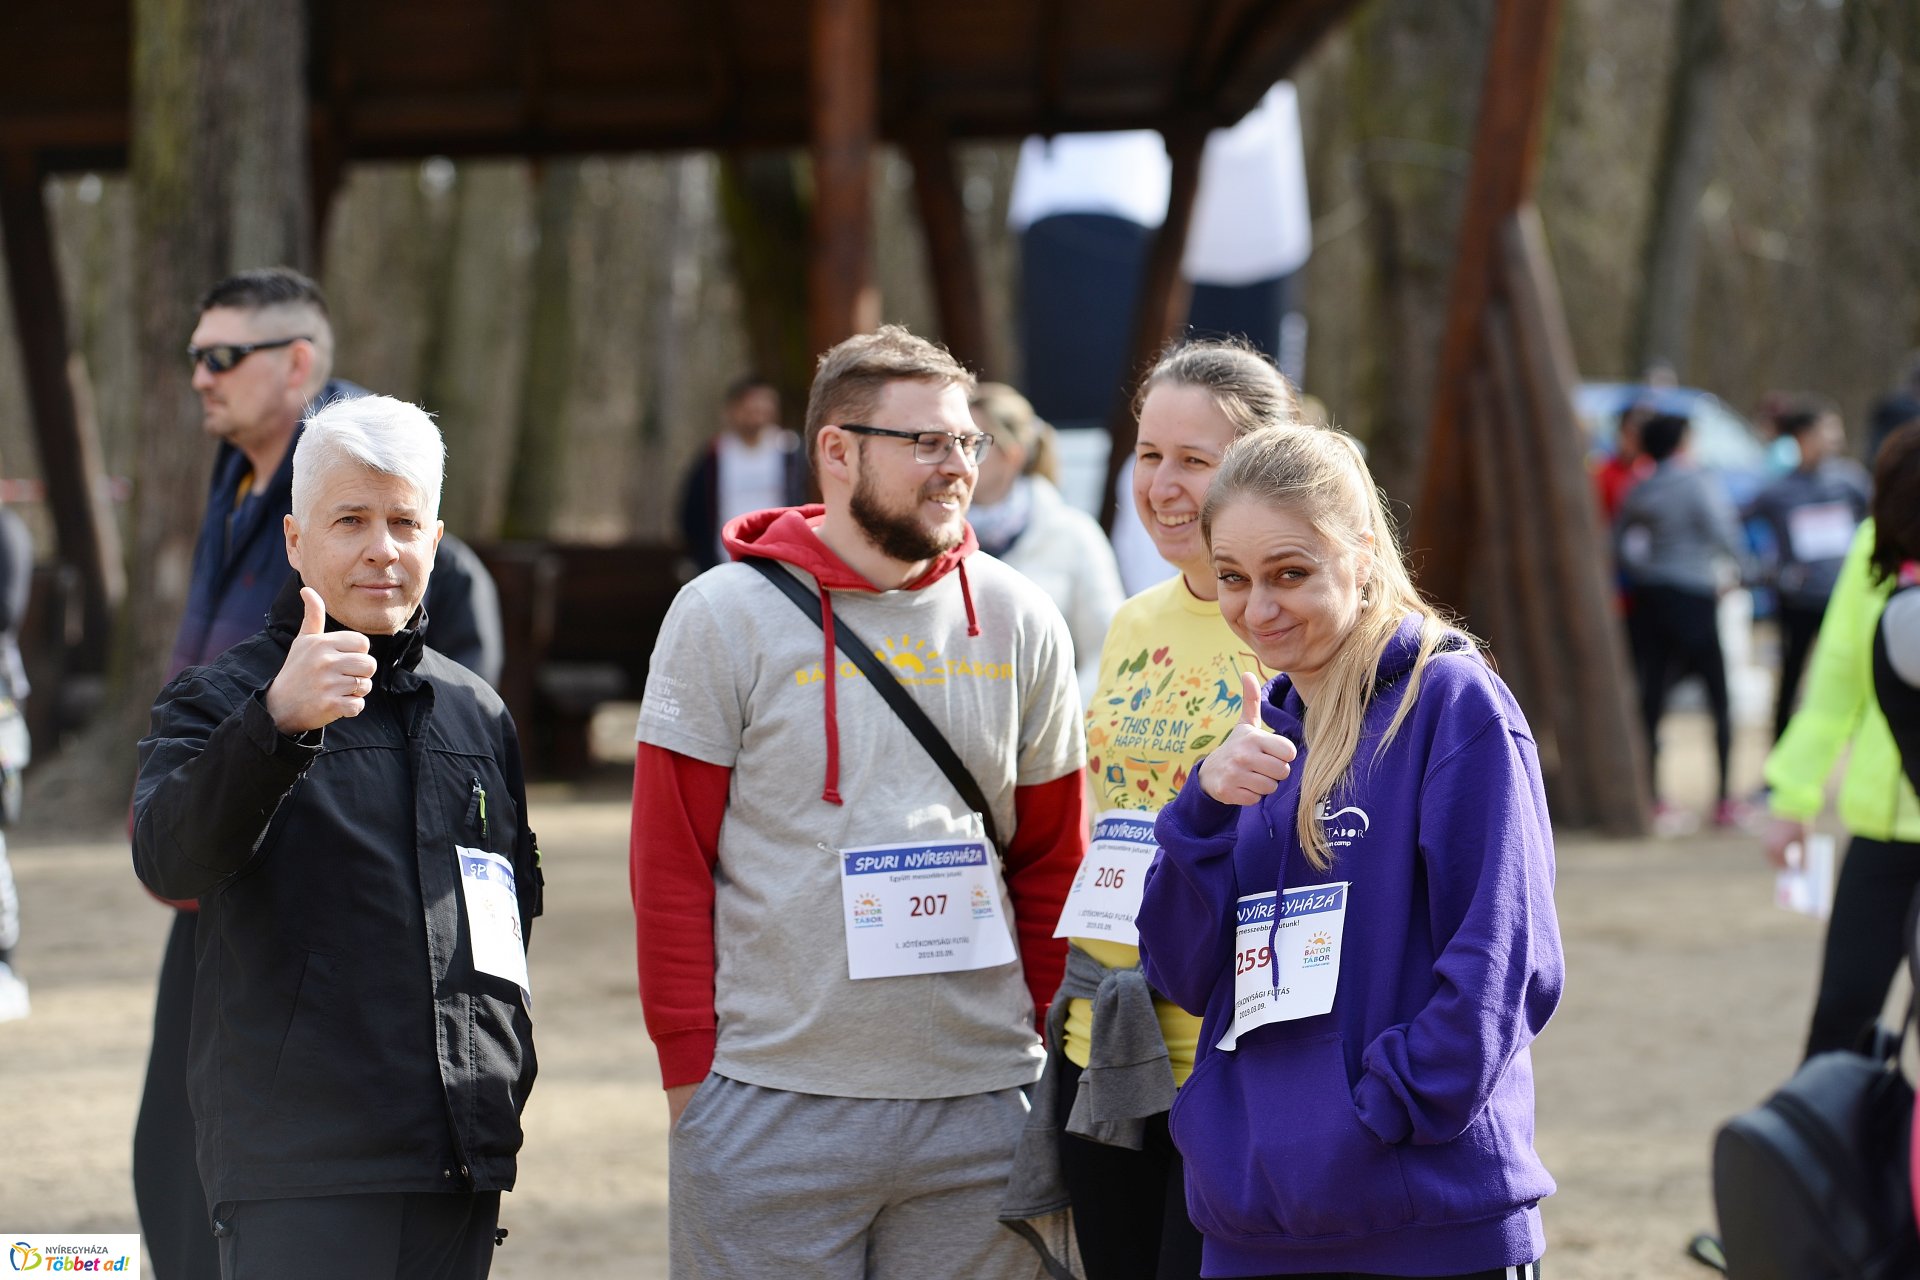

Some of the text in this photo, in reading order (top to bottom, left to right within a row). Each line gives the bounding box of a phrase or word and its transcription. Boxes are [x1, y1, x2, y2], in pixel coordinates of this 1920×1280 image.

[795, 656, 1013, 687] BÁO TÁBOR
[1120, 716, 1193, 739] THIS IS MY
[1114, 735, 1186, 753] HAPPY PLACE
[1326, 827, 1364, 838] TÁBOR
[855, 848, 983, 872] SPURI NYÍREGYHÁZA
[1094, 867, 1125, 889] 206
[909, 894, 948, 917] 207
[854, 916, 883, 925] TÁBOR
[1239, 924, 1272, 936] messzebbr
[1278, 920, 1300, 929] utunk!
[1303, 955, 1330, 964] TÁBOR
[1304, 946, 1331, 956] BÁTOR
[1236, 947, 1271, 976] 259
